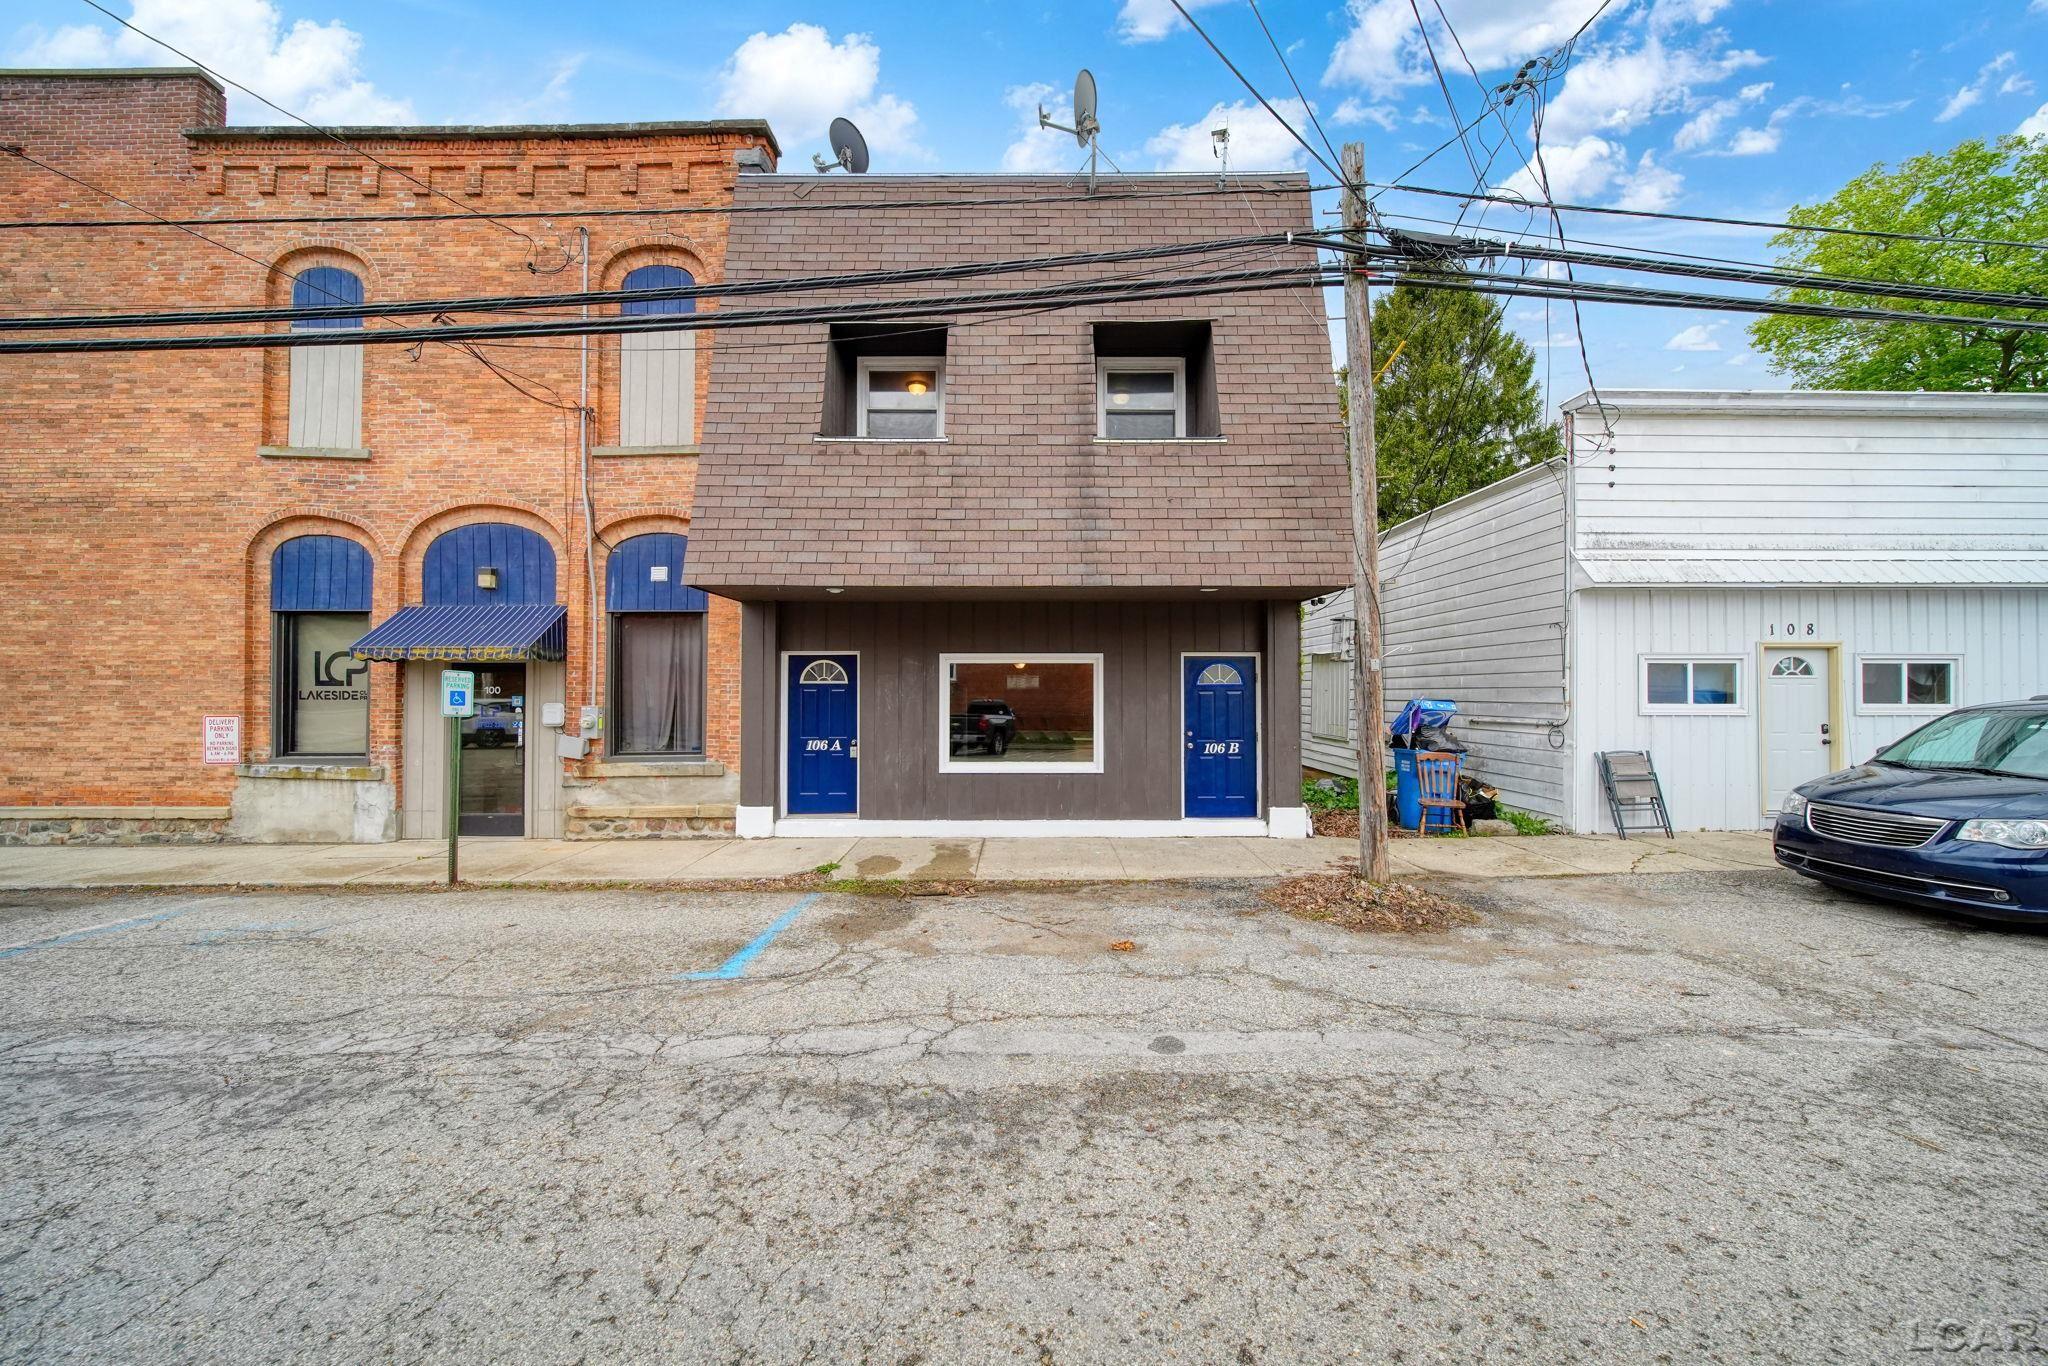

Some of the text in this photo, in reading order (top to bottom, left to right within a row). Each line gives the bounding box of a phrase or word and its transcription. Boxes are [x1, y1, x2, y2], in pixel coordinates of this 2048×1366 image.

[1770, 623, 1814, 636] 108
[299, 690, 359, 700] LAKESIDE
[484, 686, 501, 694] 100
[805, 739, 843, 751] 106 A
[1203, 742, 1240, 754] 106 B
